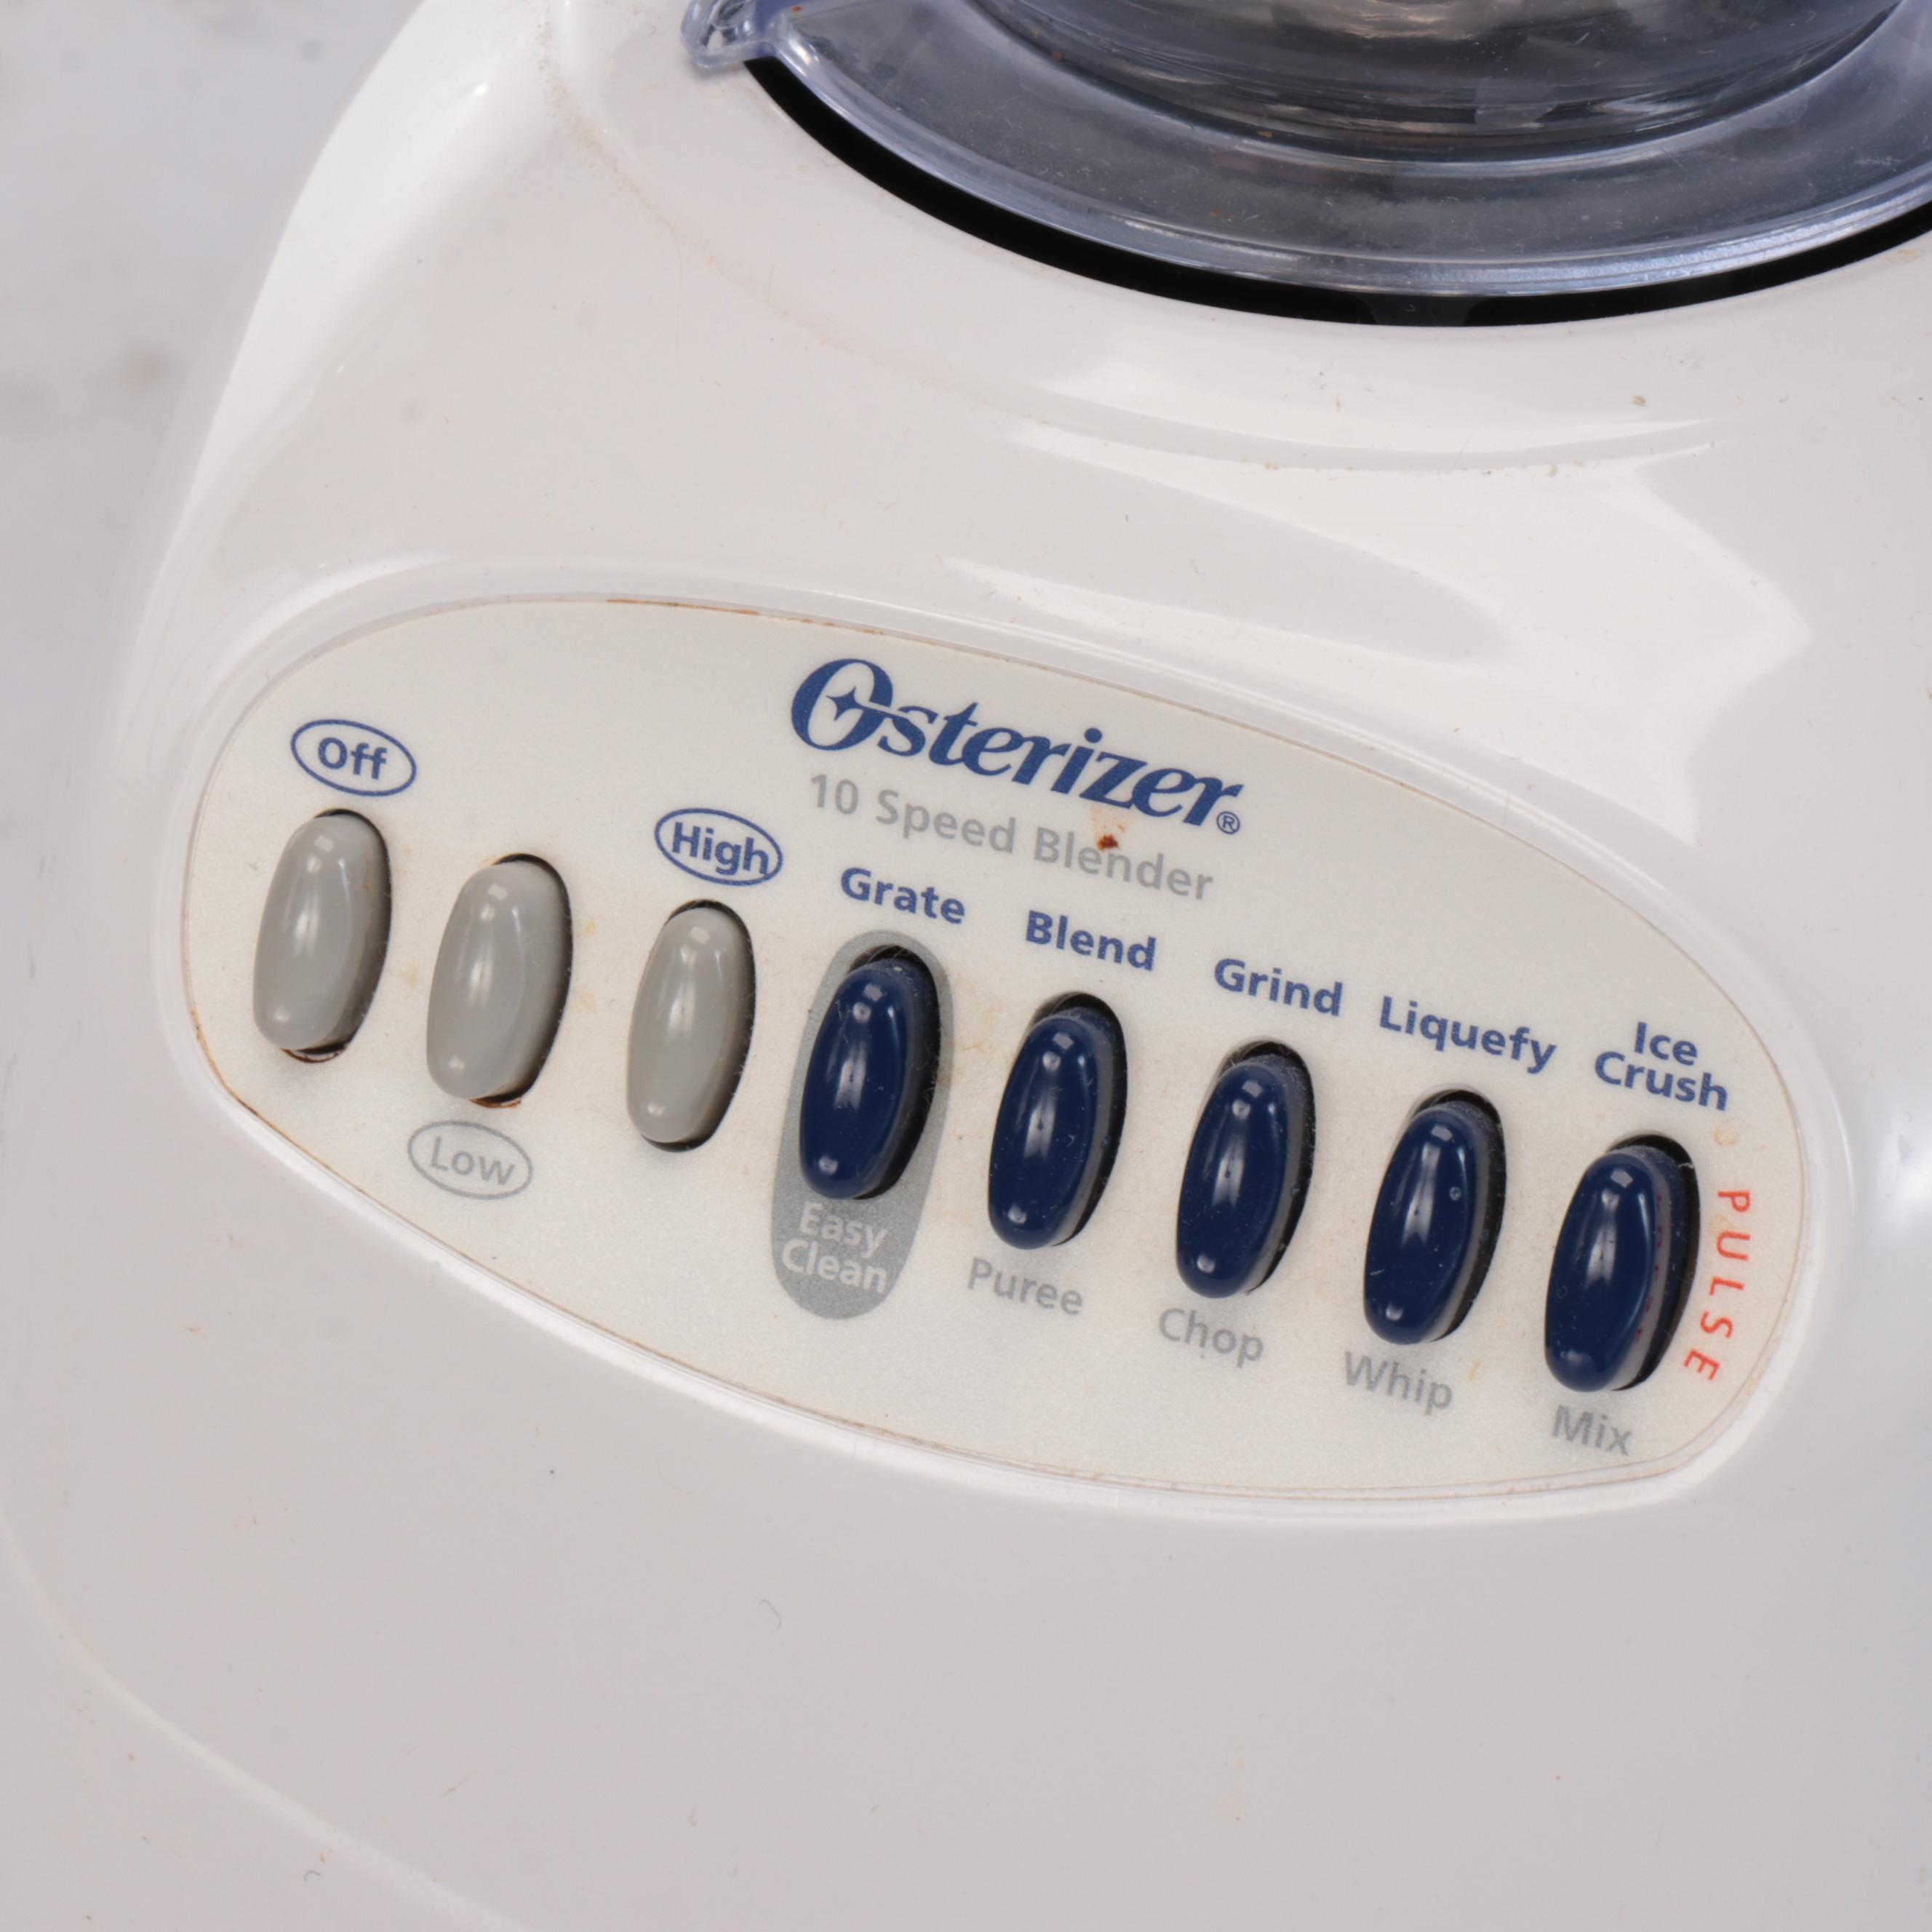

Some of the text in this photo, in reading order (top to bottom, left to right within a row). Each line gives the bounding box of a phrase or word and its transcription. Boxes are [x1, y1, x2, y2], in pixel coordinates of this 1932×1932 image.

[317, 737, 387, 780] Off
[671, 822, 770, 875] High
[810, 774, 1213, 901] 10 Speed Blender
[840, 867, 965, 924] Grate
[1026, 911, 1157, 971] Blend
[1214, 957, 1344, 1018] Grind
[1378, 996, 1557, 1074] Liquefy
[1634, 1022, 1699, 1065] Ice
[1594, 1051, 1728, 1111] Crush
[430, 1137, 515, 1186] Low
[799, 1202, 888, 1259] Easy
[781, 1239, 888, 1295] Clean
[967, 1256, 1083, 1316] Puree
[1682, 1189, 1751, 1381] PULSE
[1157, 1308, 1264, 1368] Chop
[1344, 1351, 1453, 1416] Whip
[1552, 1405, 1634, 1456] Mix
